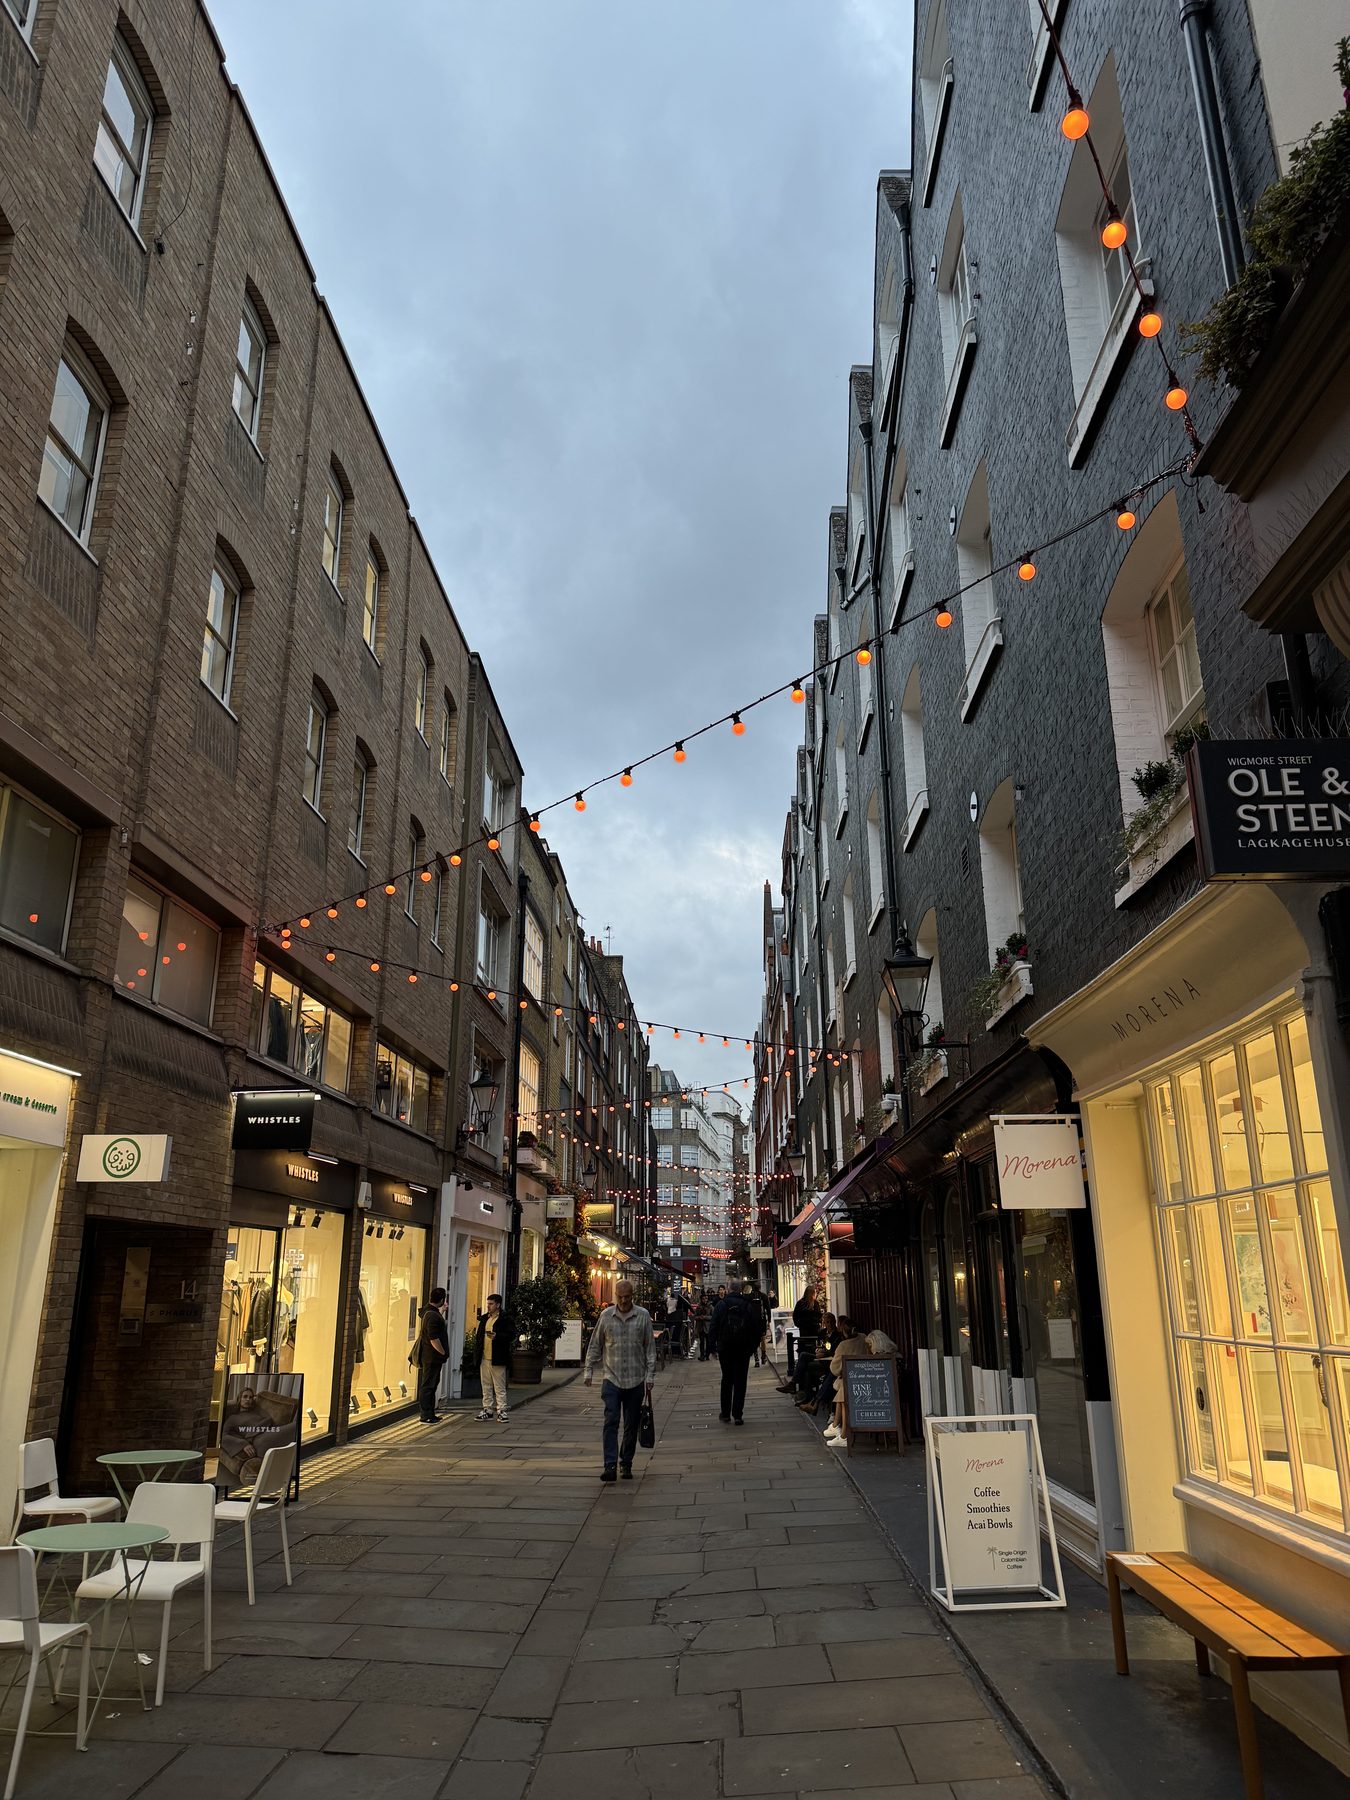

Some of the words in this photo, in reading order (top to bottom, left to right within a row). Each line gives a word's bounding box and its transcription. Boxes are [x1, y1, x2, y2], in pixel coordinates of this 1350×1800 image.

[1227, 756, 1276, 766] WIGMORE
[1277, 755, 1313, 765] STREET
[1227, 767, 1305, 798] OLE
[1321, 766, 1350, 796] &
[1236, 803, 1350, 833] STEEN
[1110, 978, 1201, 1042] MORENA
[247, 1116, 301, 1124] WHISTLES
[286, 1163, 319, 1183] WHISTLES
[1002, 1154, 1078, 1179] Morena
[177, 1279, 198, 1300] 14
[964, 1457, 1005, 1473] Morena
[973, 1486, 1001, 1498] Coffee
[966, 1502, 1011, 1514] Smoothies
[967, 1519, 987, 1530] Acai
[987, 1517, 1014, 1530] Bowls
